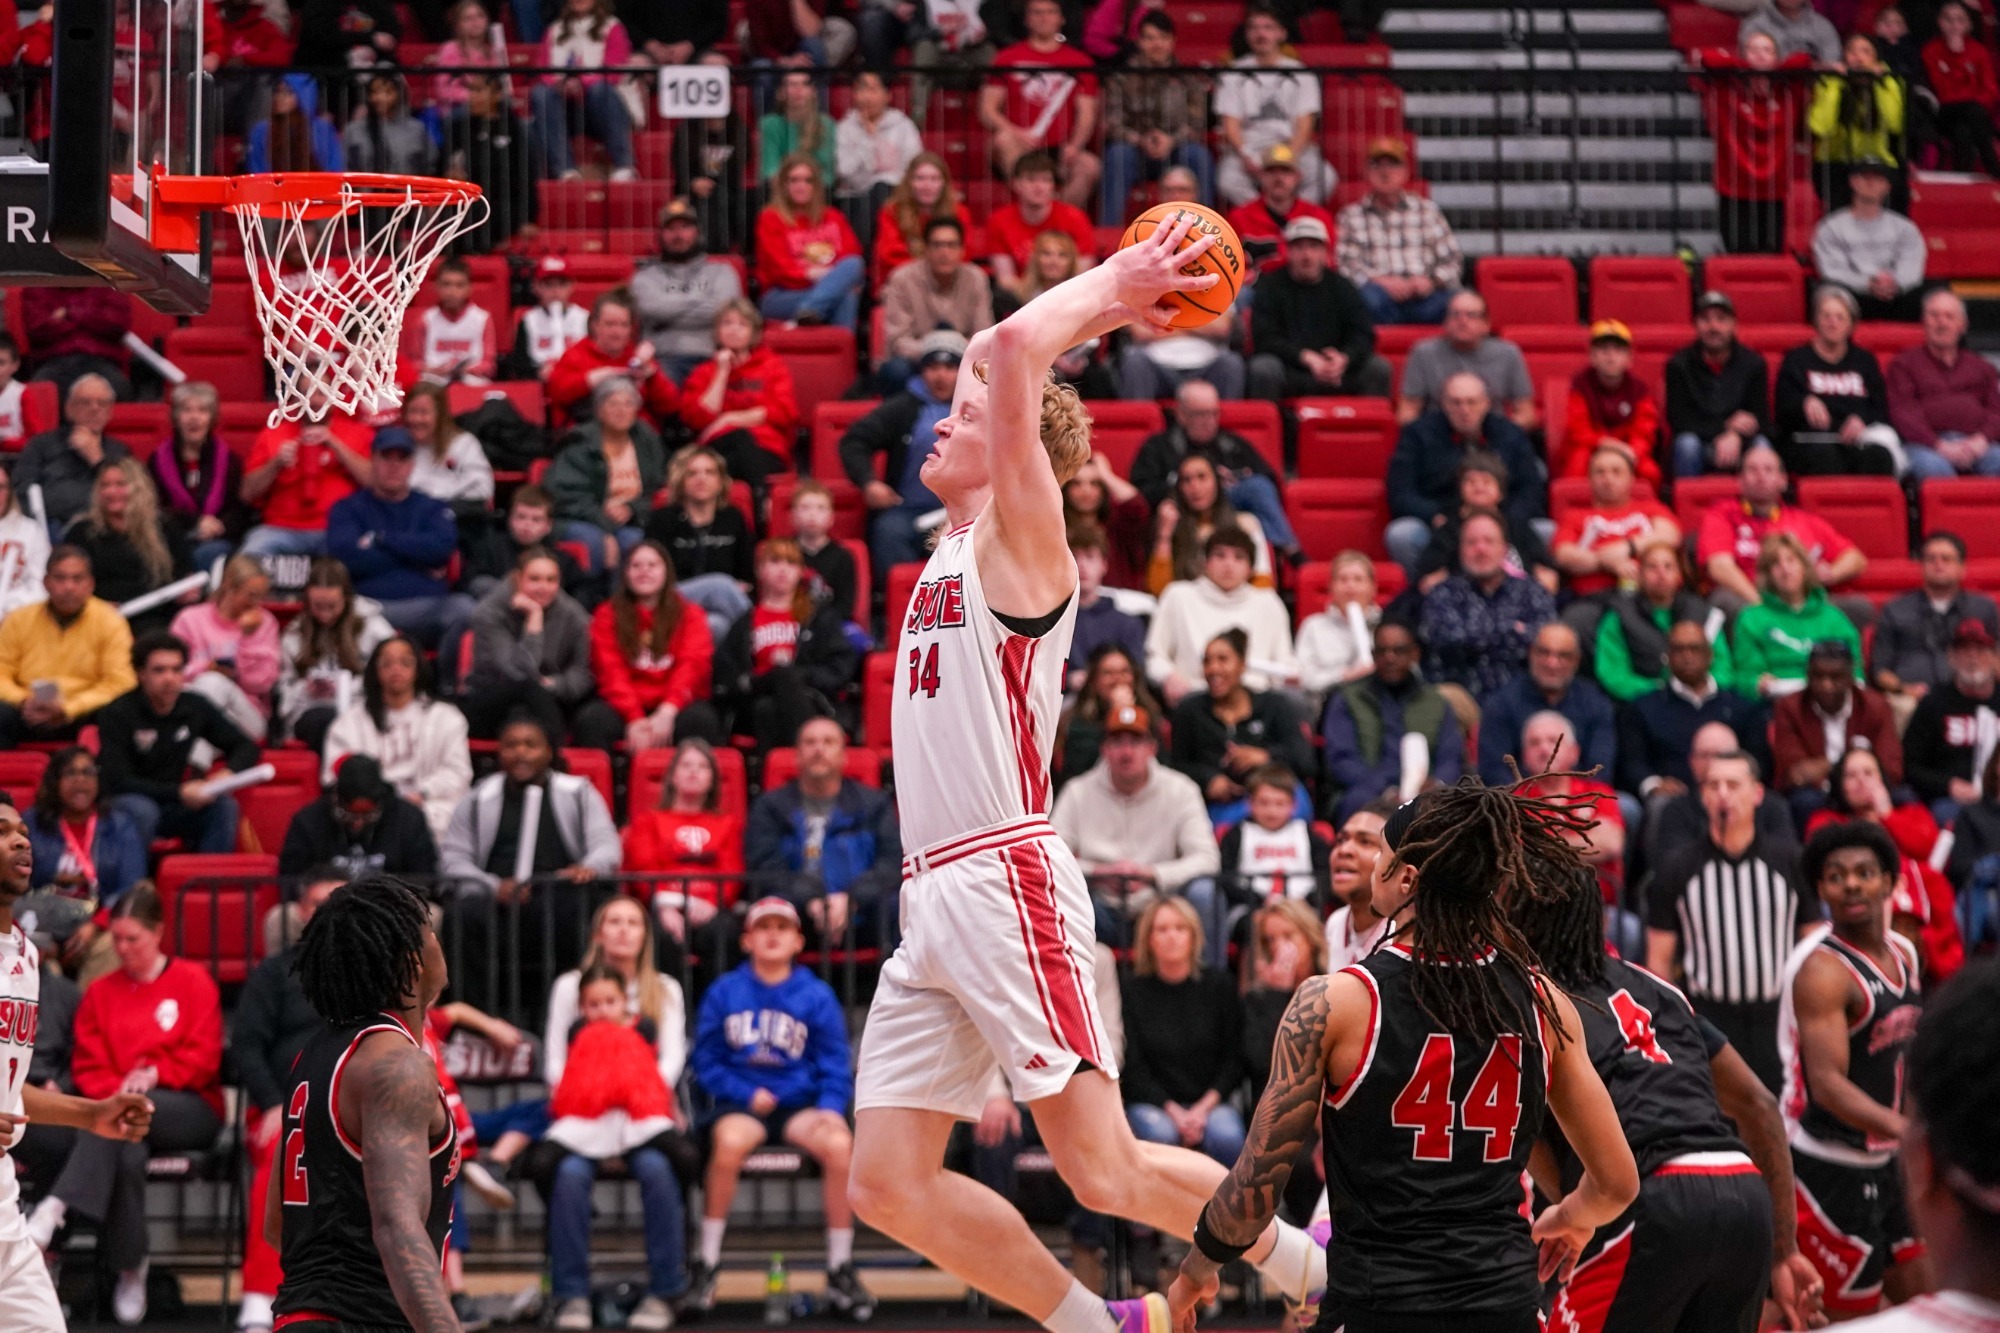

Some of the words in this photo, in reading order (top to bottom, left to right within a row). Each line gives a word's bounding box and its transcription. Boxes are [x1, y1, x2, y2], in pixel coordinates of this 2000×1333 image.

[668, 79, 721, 105] 109
[7, 205, 51, 244] R
[1607, 988, 1673, 1066] 4
[1391, 1033, 1522, 1162] 44
[283, 1081, 310, 1206] 2
